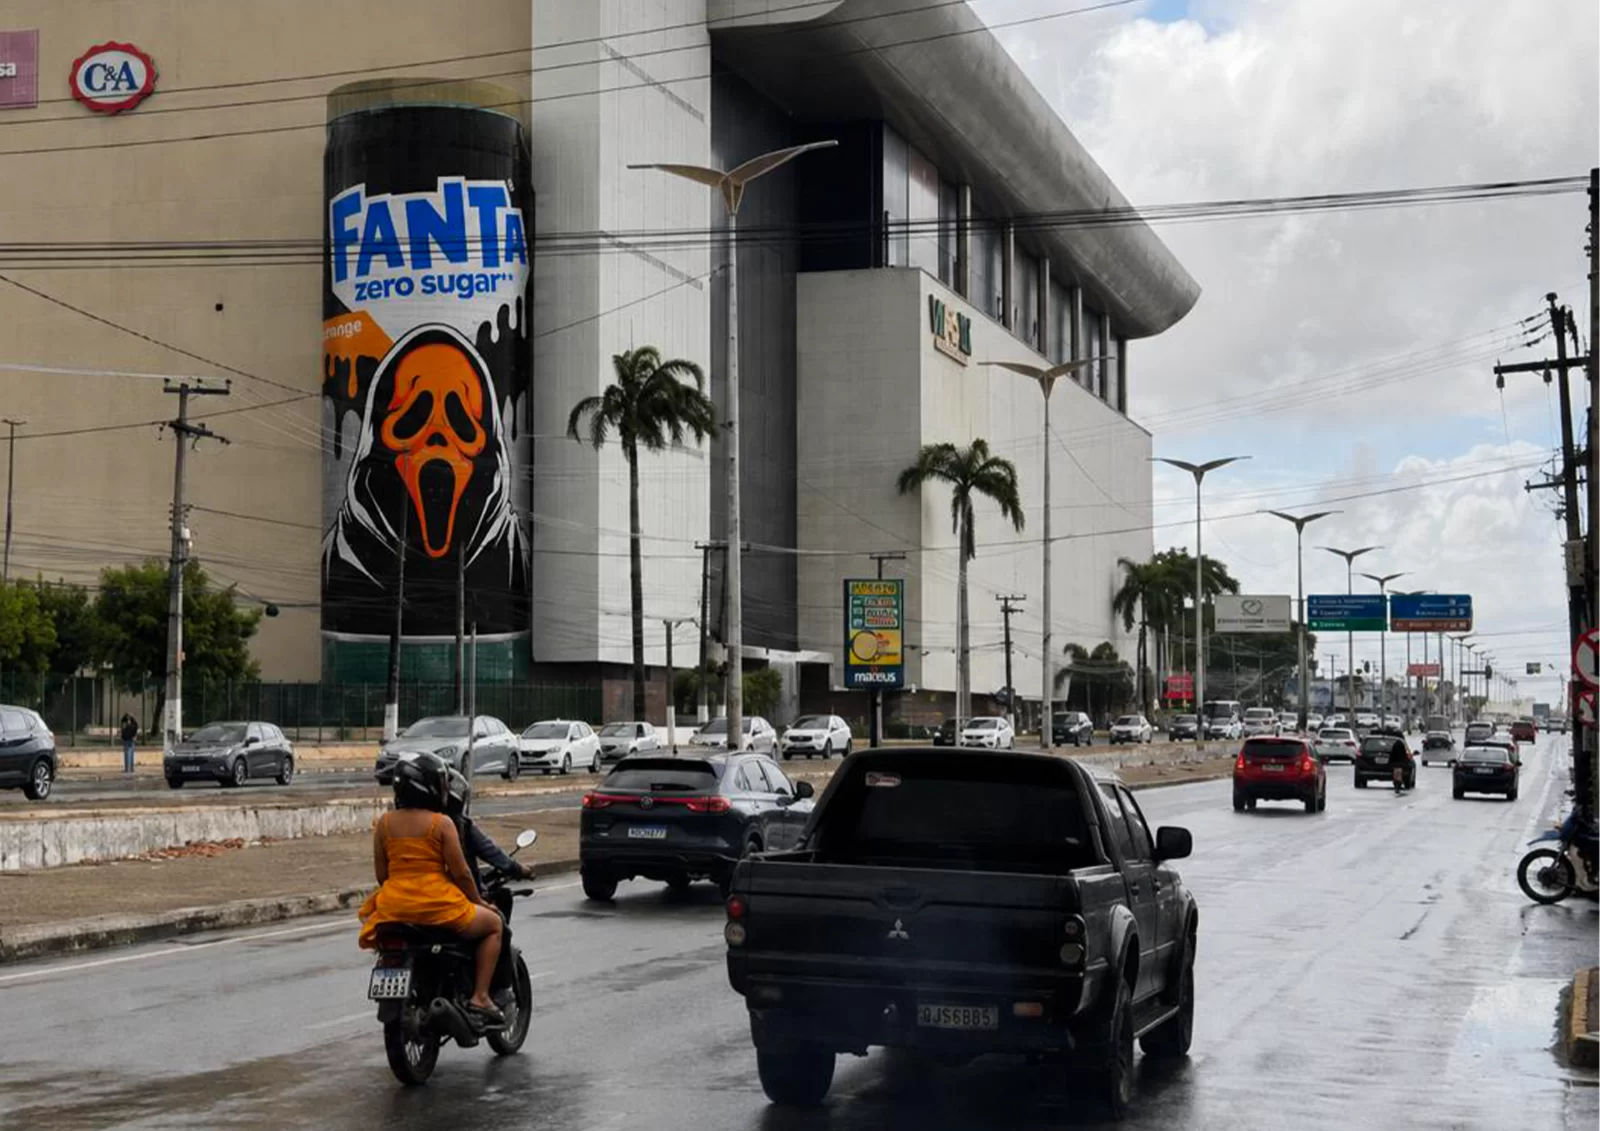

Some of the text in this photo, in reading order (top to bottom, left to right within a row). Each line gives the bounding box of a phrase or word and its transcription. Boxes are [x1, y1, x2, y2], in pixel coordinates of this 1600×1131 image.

[84, 60, 139, 92] C&A
[332, 182, 527, 284] FANTA
[354, 276, 415, 302] zero
